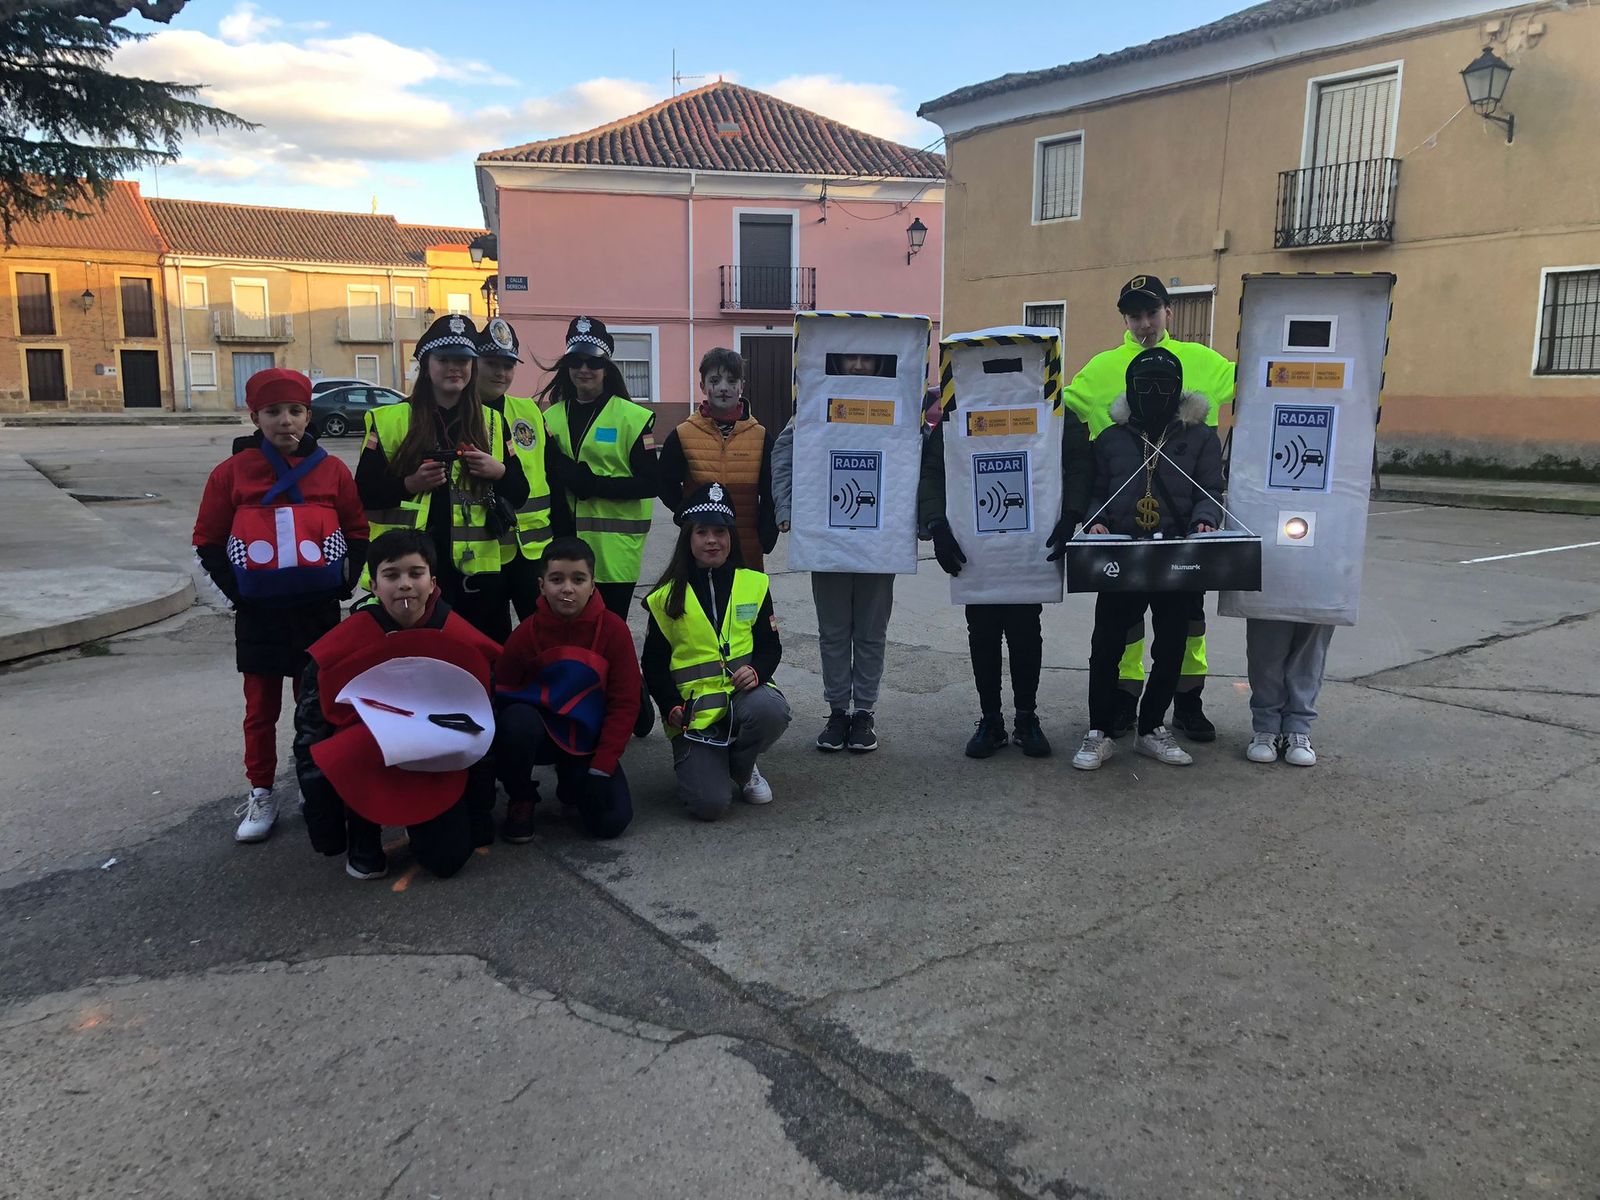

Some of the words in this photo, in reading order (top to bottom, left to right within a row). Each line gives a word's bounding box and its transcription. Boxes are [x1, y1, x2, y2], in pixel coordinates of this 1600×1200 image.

[1280, 413, 1325, 425] RADAR
[835, 458, 875, 469] RADAR
[979, 460, 1020, 472] RADAR
